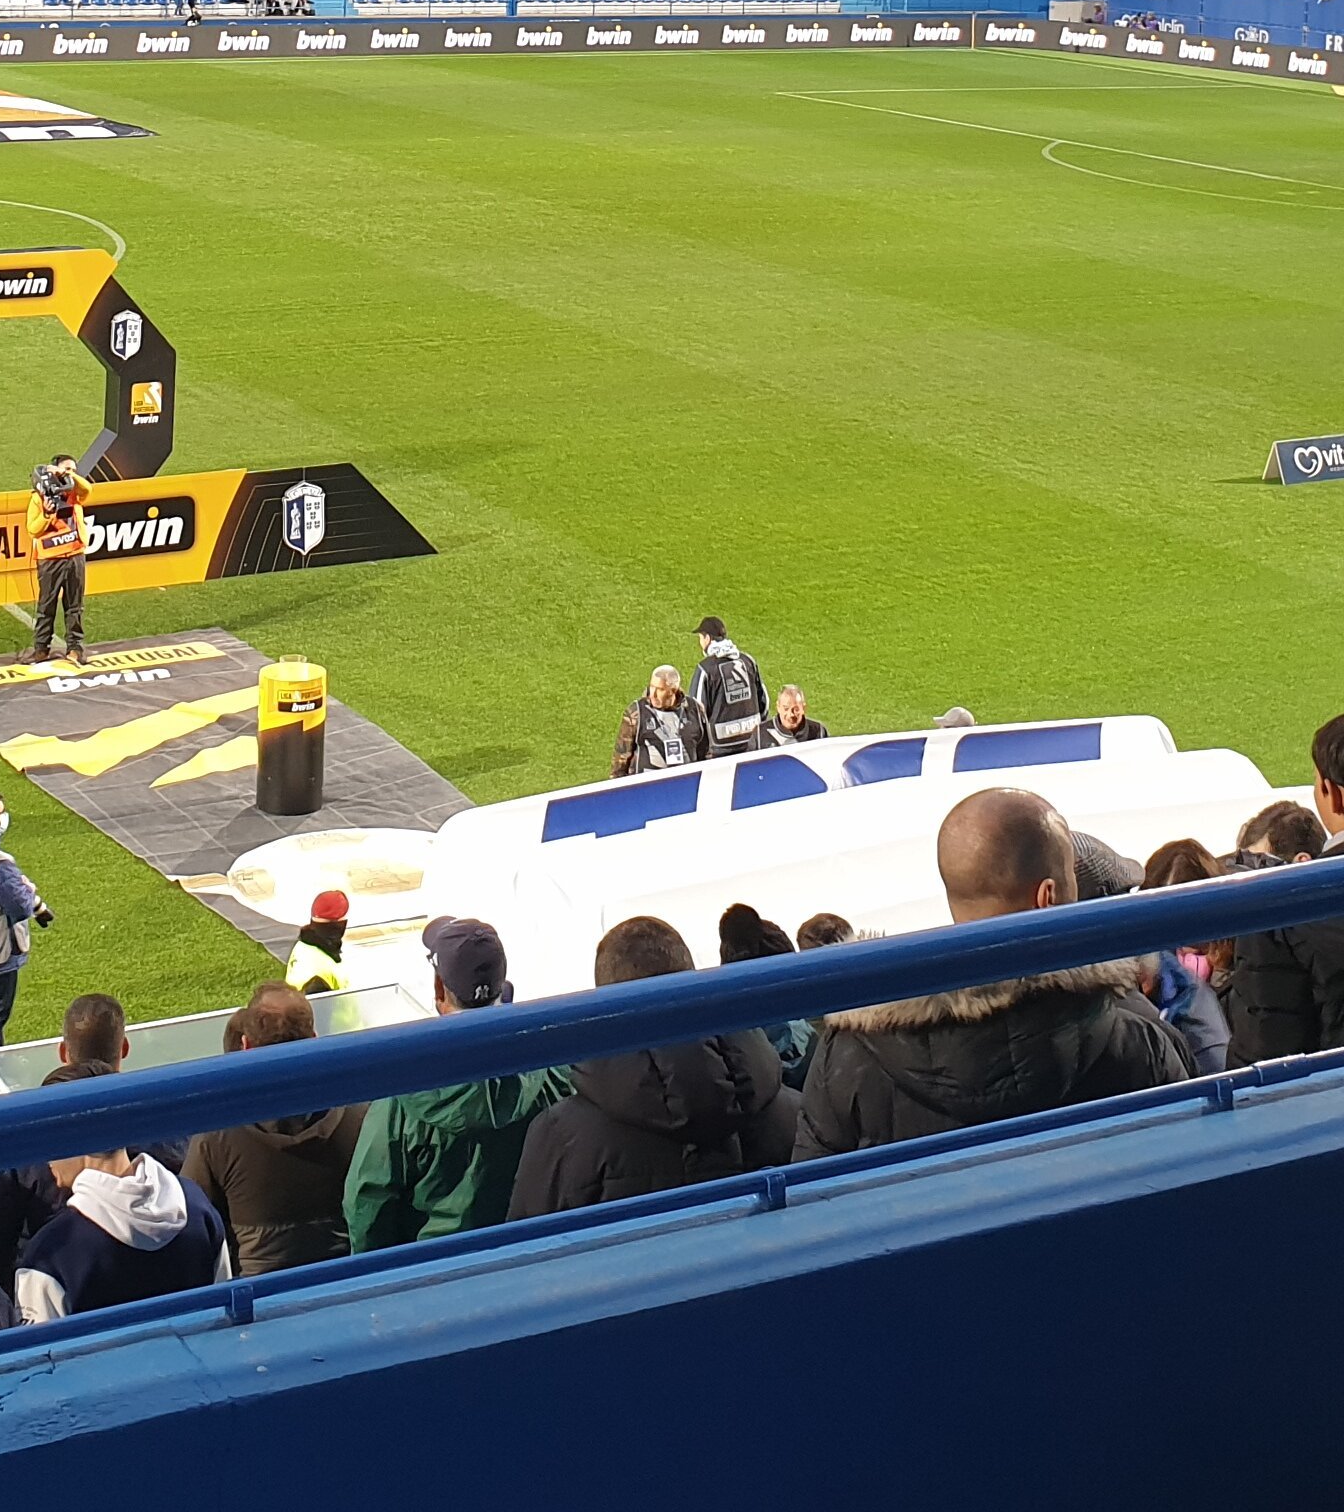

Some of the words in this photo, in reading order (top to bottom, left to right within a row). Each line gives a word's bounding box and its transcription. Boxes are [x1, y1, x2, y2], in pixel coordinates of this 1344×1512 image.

[136, 31, 191, 54] bwin
[218, 30, 270, 52] bwin
[296, 28, 346, 50] bwin
[370, 28, 420, 49] bwin
[444, 26, 492, 48] bwin
[516, 26, 563, 47] bwin
[586, 24, 632, 46] bwin
[654, 24, 700, 44] bwin
[722, 23, 765, 44] bwin
[786, 22, 828, 43] bwin
[850, 22, 893, 42] bwin
[914, 22, 961, 42] bwin
[985, 22, 1036, 43] bwin
[1059, 28, 1108, 49] bwin
[52, 32, 109, 55] bwin
[1126, 34, 1164, 56] bwin
[1178, 39, 1216, 62] bwin
[1232, 45, 1270, 69] bwin
[1288, 51, 1327, 76] bwin
[133, 414, 159, 425] bwin
[84, 506, 184, 555] bwin
[46, 668, 170, 693] bwin
[292, 700, 316, 712] bwin
